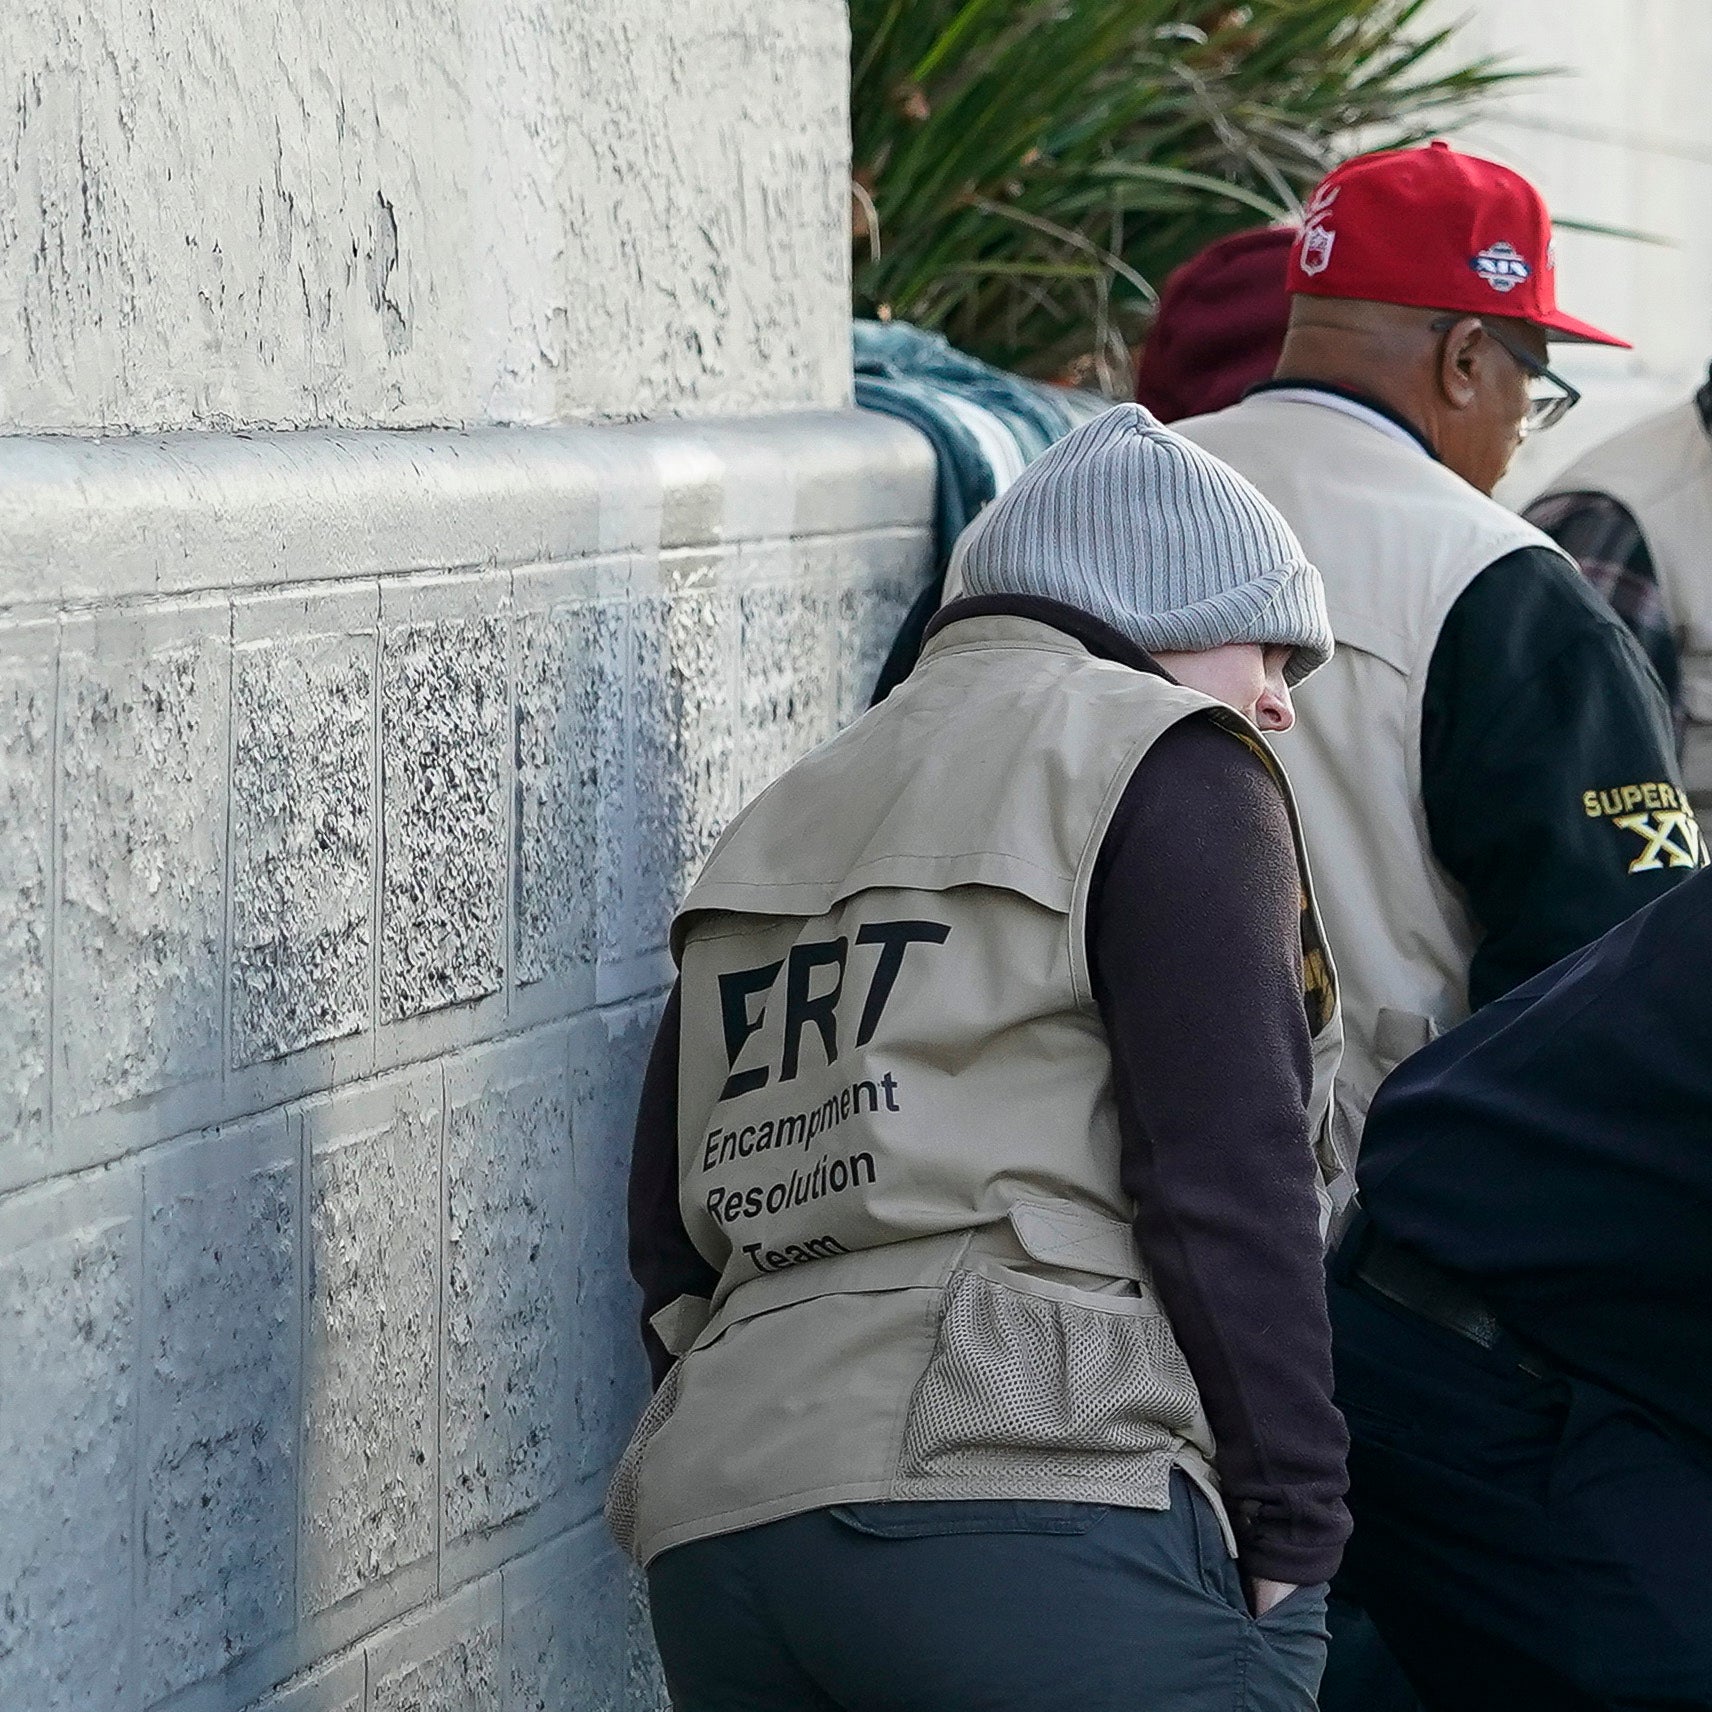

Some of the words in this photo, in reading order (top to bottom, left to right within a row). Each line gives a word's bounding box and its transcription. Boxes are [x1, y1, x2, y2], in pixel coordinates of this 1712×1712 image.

[1582, 781, 1679, 818] SUPER
[717, 920, 952, 1102] ERT
[702, 1071, 901, 1174] Encampment
[705, 1150, 876, 1226] Resolution
[742, 1234, 851, 1273] Team
